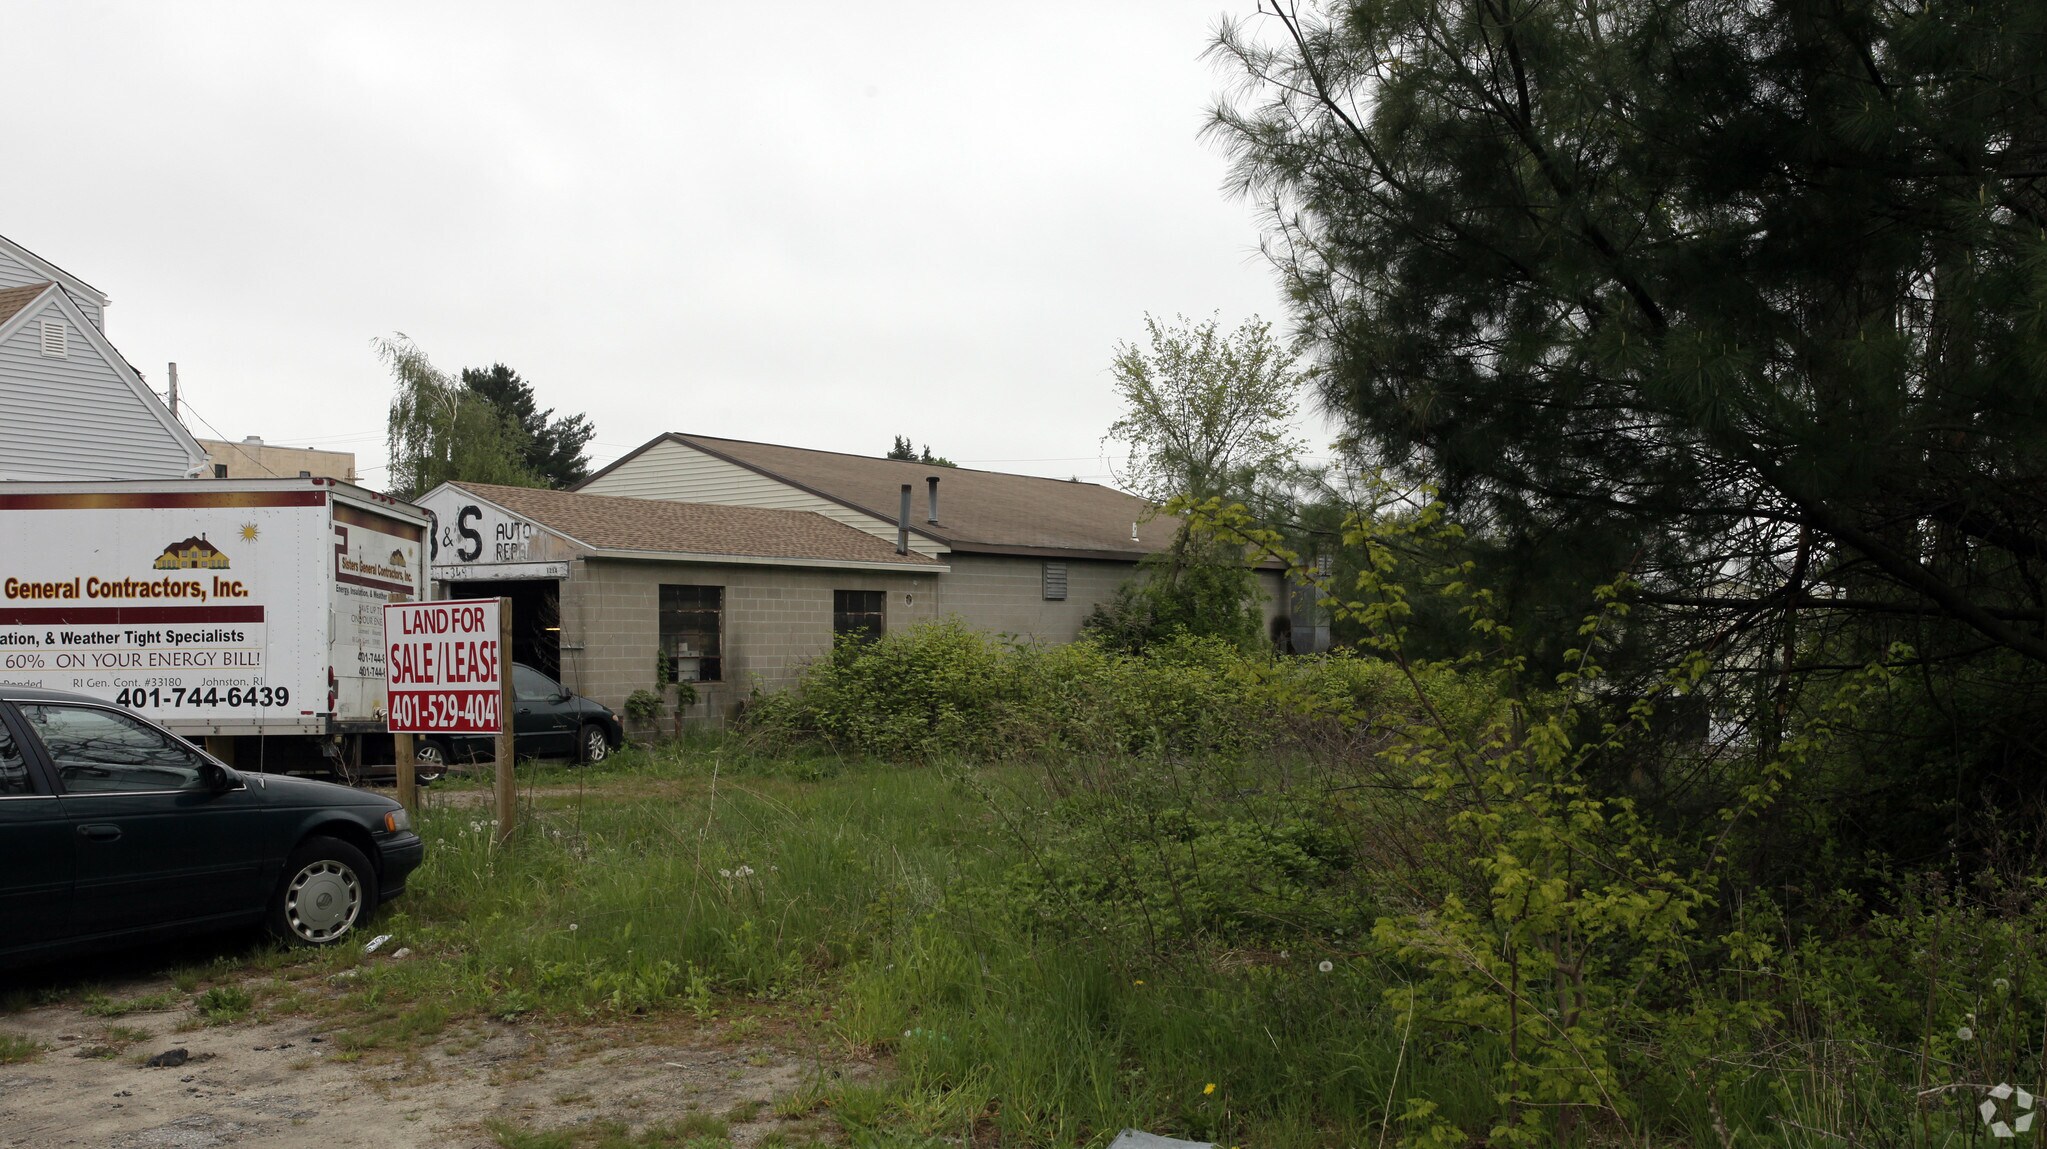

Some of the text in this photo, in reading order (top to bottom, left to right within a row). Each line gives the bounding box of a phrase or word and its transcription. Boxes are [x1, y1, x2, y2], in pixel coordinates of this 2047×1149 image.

[443, 526, 454, 547] &
[457, 505, 482, 562] S
[496, 522, 531, 541] AUTO
[342, 556, 358, 572] Sisters
[360, 560, 377, 576] General
[377, 564, 404, 583] Contractors,
[4, 575, 248, 603] General Contractors, Inc.
[402, 607, 485, 635] LAND FOR
[45, 631, 55, 645] &
[60, 631, 120, 645] Weather
[124, 630, 161, 647] Tight
[165, 629, 245, 646] Specialists
[5, 651, 260, 669] 60% ON YOUR ENERGY BILL!
[73, 679, 83, 688] RI
[86, 678, 110, 688] Gen.
[113, 677, 140, 688] Cont.
[144, 677, 182, 687] #33180
[201, 676, 249, 687] Johnston,
[253, 676, 263, 686] RI
[115, 686, 289, 708] 401-744-6439
[391, 693, 500, 728] 401-529-4041
